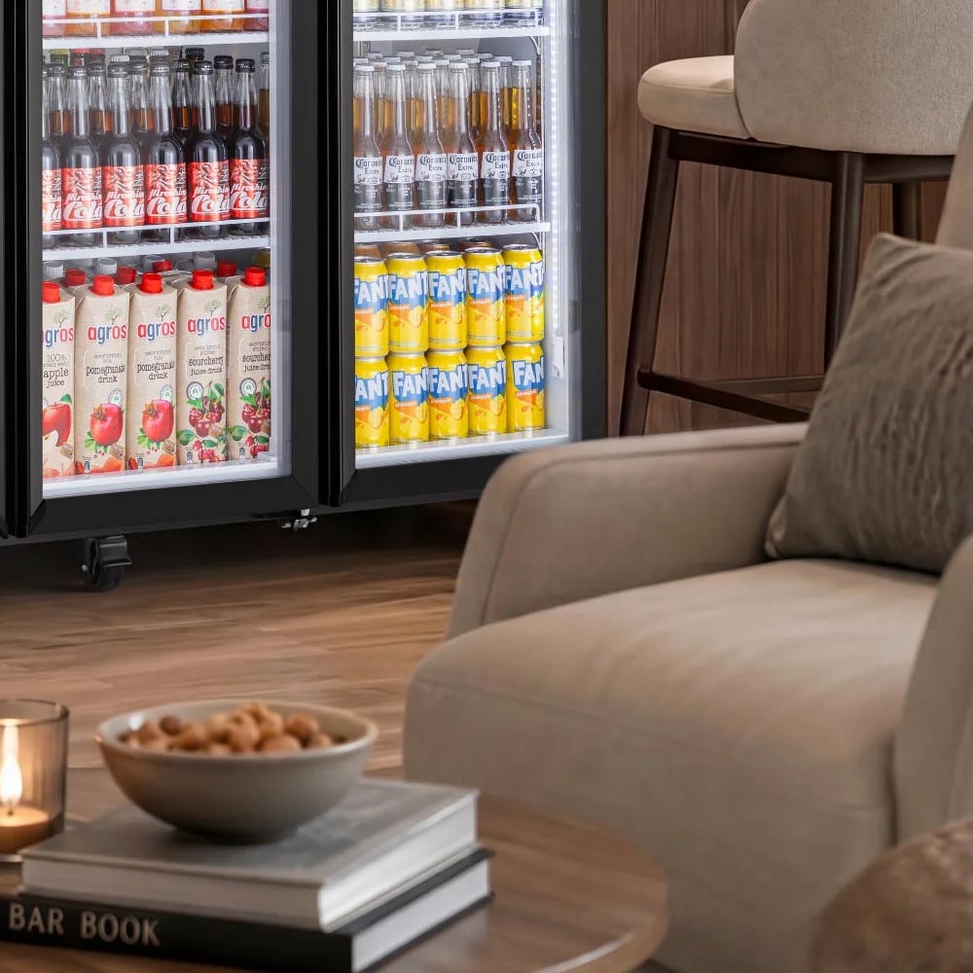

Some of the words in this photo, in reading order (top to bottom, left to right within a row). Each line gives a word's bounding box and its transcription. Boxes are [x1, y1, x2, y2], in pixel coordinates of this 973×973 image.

[88, 324, 127, 344] agros
[137, 321, 176, 341] agros
[188, 316, 225, 336] agros
[43, 327, 74, 347] gros
[44, 368, 69, 380] apple
[9, 903, 65, 936] BAR
[81, 911, 161, 947] BOOK
